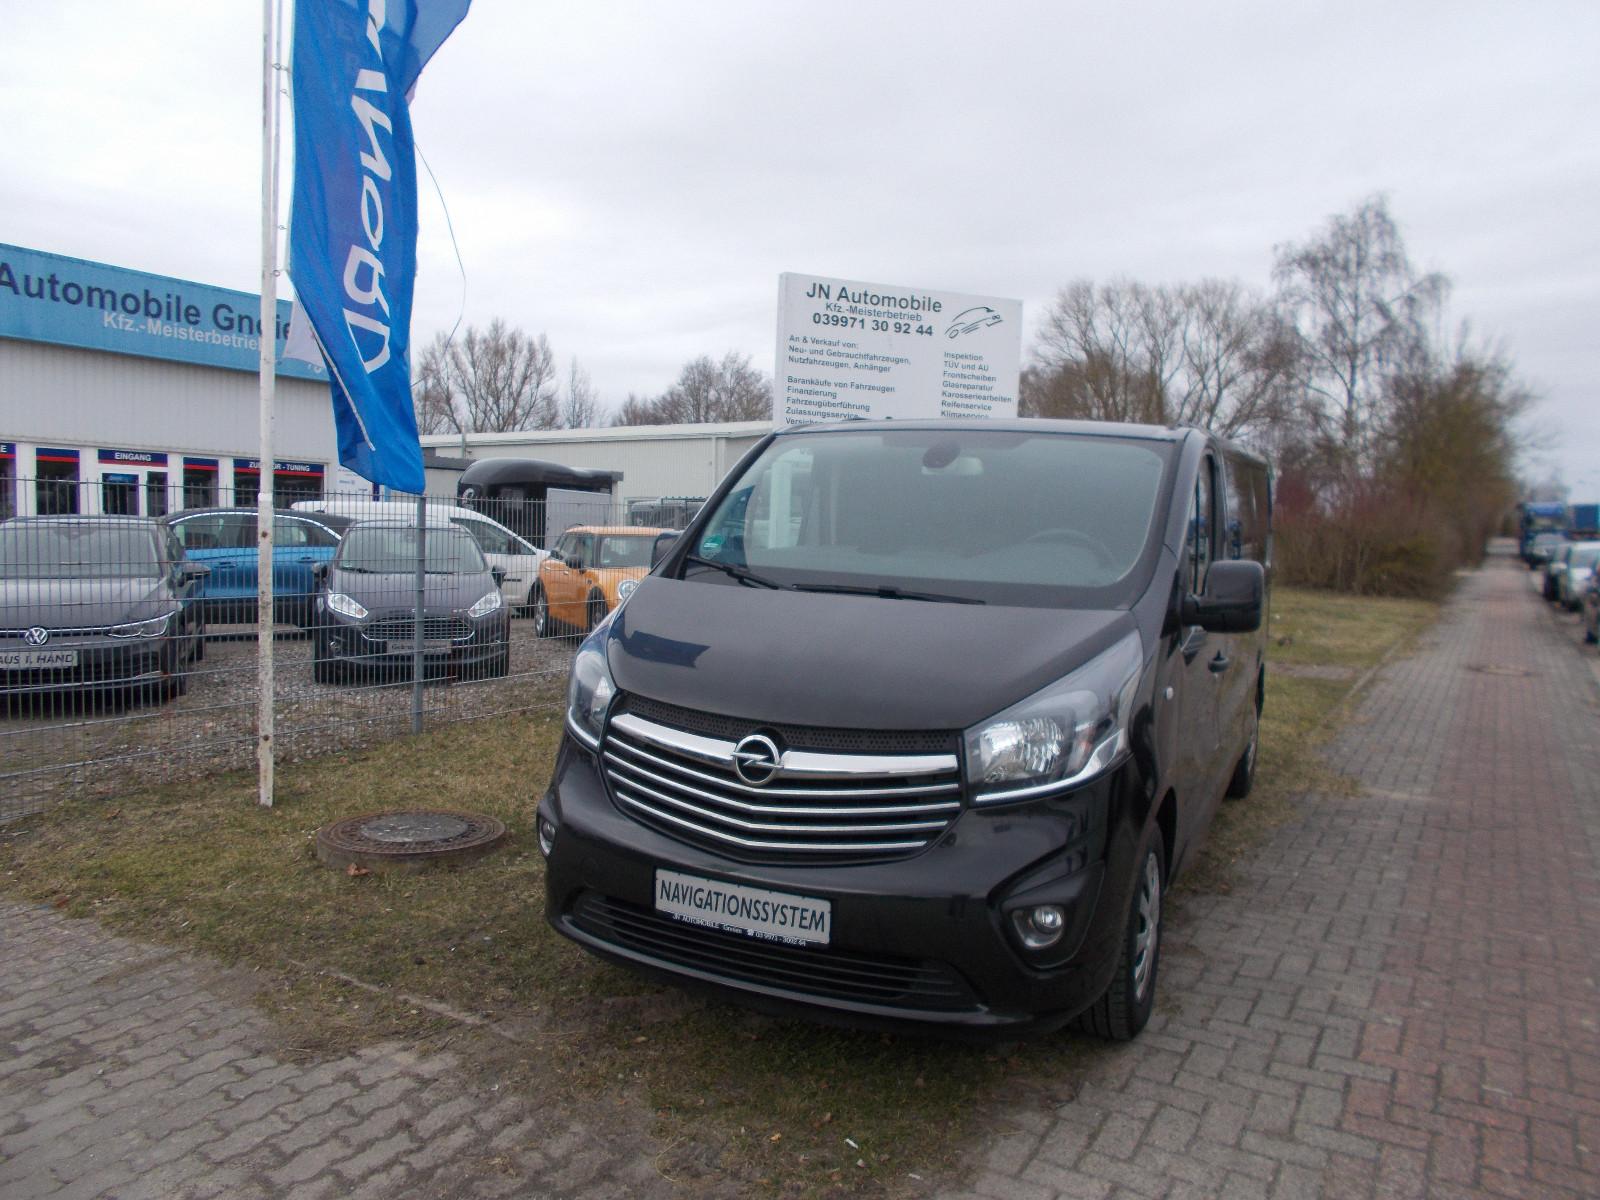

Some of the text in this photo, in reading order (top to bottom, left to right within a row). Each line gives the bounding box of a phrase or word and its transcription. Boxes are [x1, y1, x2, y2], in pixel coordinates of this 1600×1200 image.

[0, 262, 290, 340] Automobile Gni
[806, 282, 943, 312] JN Automobile
[825, 302, 922, 322] Kfz.-Meisterbetrieb
[103, 310, 263, 352] Kfz.-Meisterbetrie
[812, 312, 934, 337] 039971 30 92 44
[789, 334, 800, 342] An
[810, 337, 841, 347] Verkauf
[809, 348, 824, 356] und
[944, 351, 984, 361] Inspektion
[853, 361, 892, 373] Anhänger
[787, 386, 838, 399] Finanzierung
[834, 381, 848, 389] von
[850, 381, 896, 394] Fahrzeugen
[114, 452, 152, 462] EINGANG
[287, 463, 310, 471] TUNING
[36, 654, 74, 664] HAND
[660, 879, 825, 933] NAVIGATIONSSYSTEM
